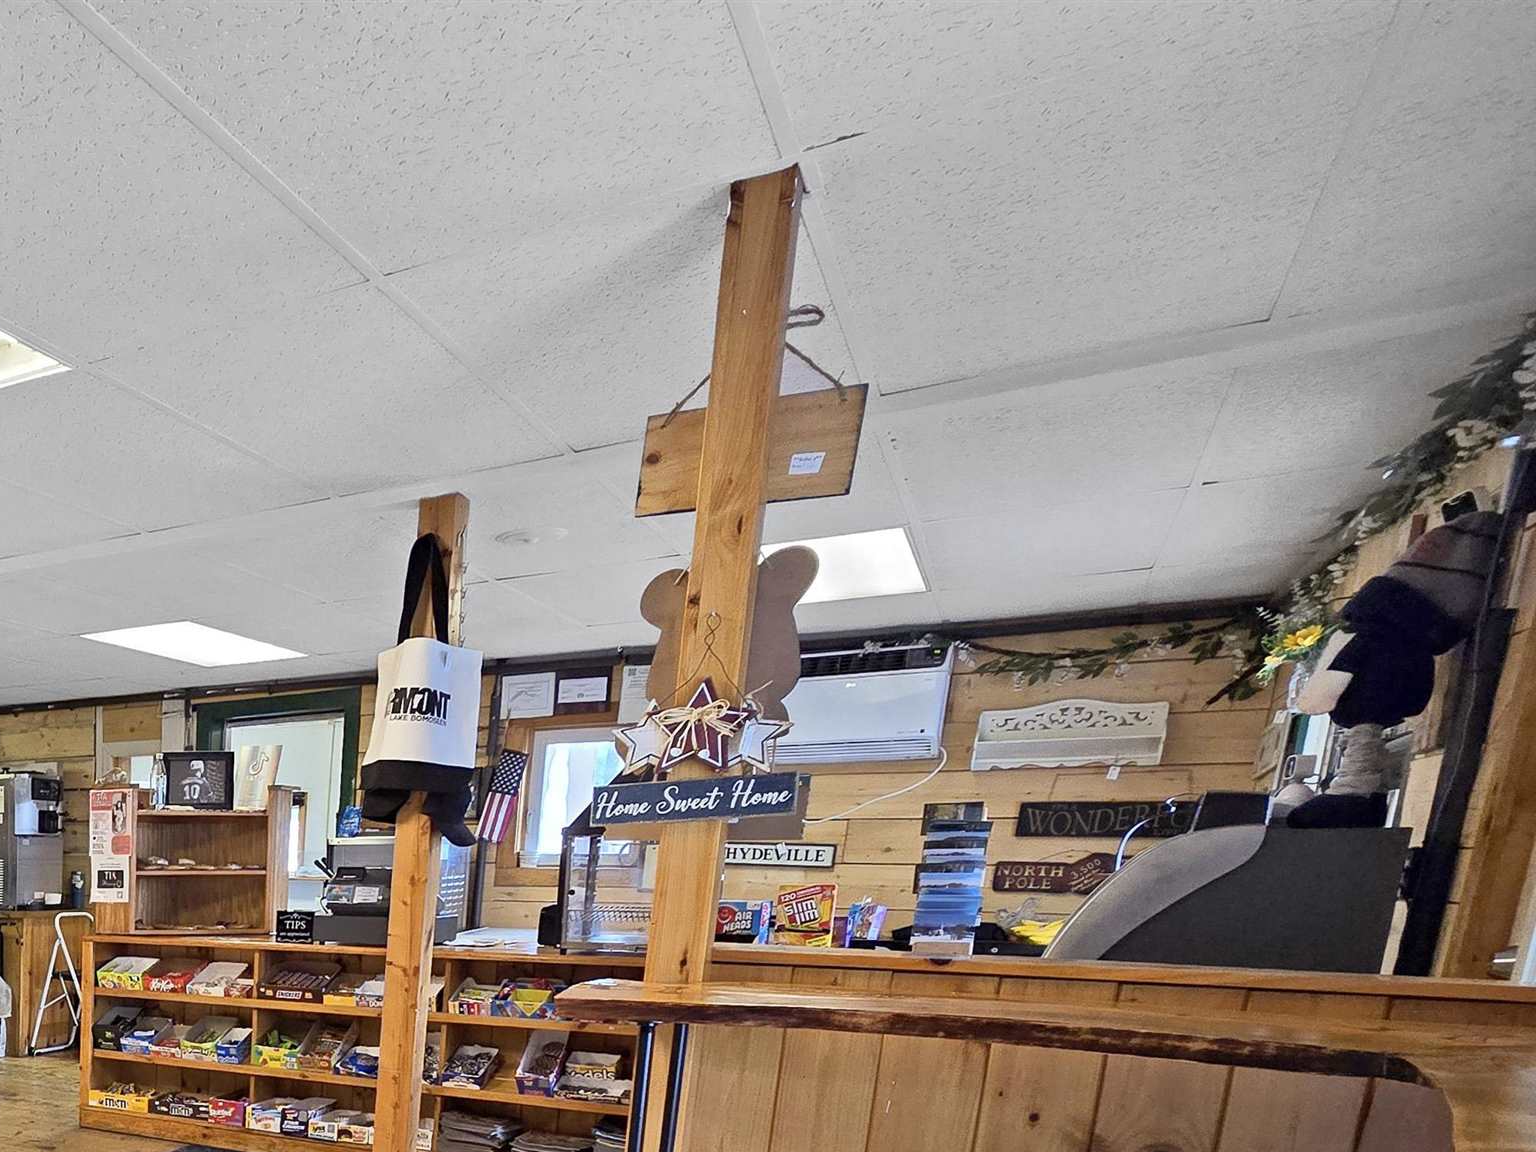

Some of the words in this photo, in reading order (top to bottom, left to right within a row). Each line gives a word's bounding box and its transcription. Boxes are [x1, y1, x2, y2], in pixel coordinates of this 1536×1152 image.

[183, 784, 201, 800] 10
[595, 791, 652, 820] Home
[656, 784, 724, 815] Sweet
[730, 778, 793, 810] Home
[726, 846, 826, 863] HYDEVILLE
[997, 864, 1065, 878] NORTH
[1003, 877, 1052, 890] POLE
[735, 911, 753, 922] AIR
[284, 920, 306, 930] TIPS
